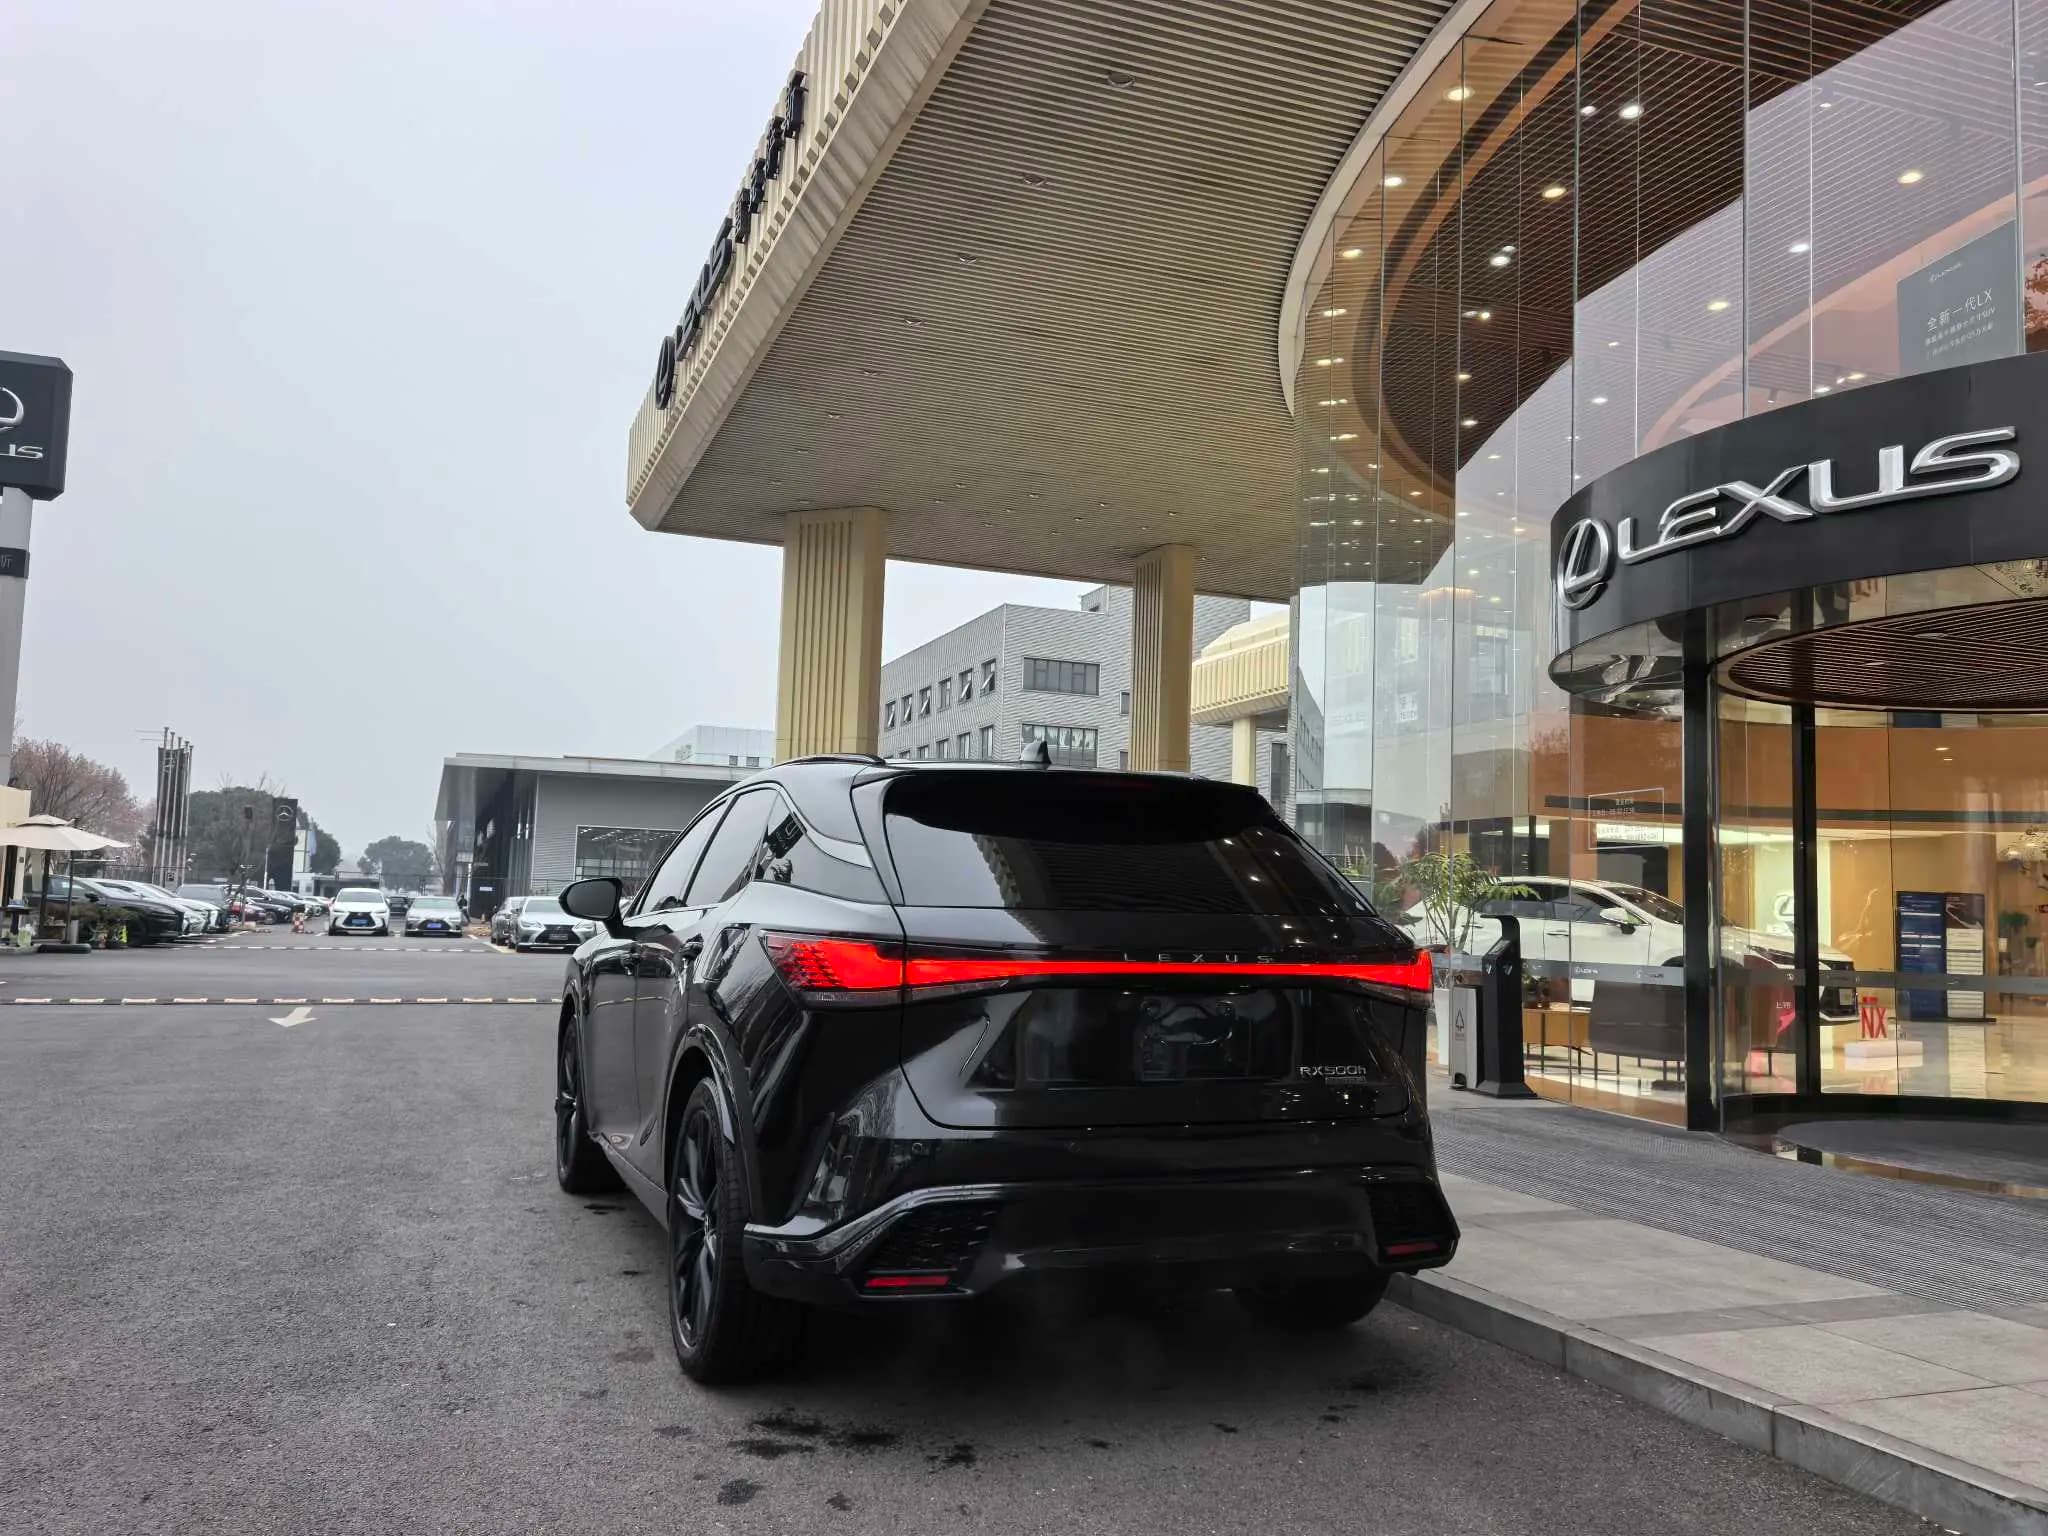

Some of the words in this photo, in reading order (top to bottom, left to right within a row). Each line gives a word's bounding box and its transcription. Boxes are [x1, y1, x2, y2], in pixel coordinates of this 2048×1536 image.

[1617, 425, 2021, 565] LEXUS
[1124, 953, 1274, 963] LEXUS
[1860, 1007, 1888, 1039] NX
